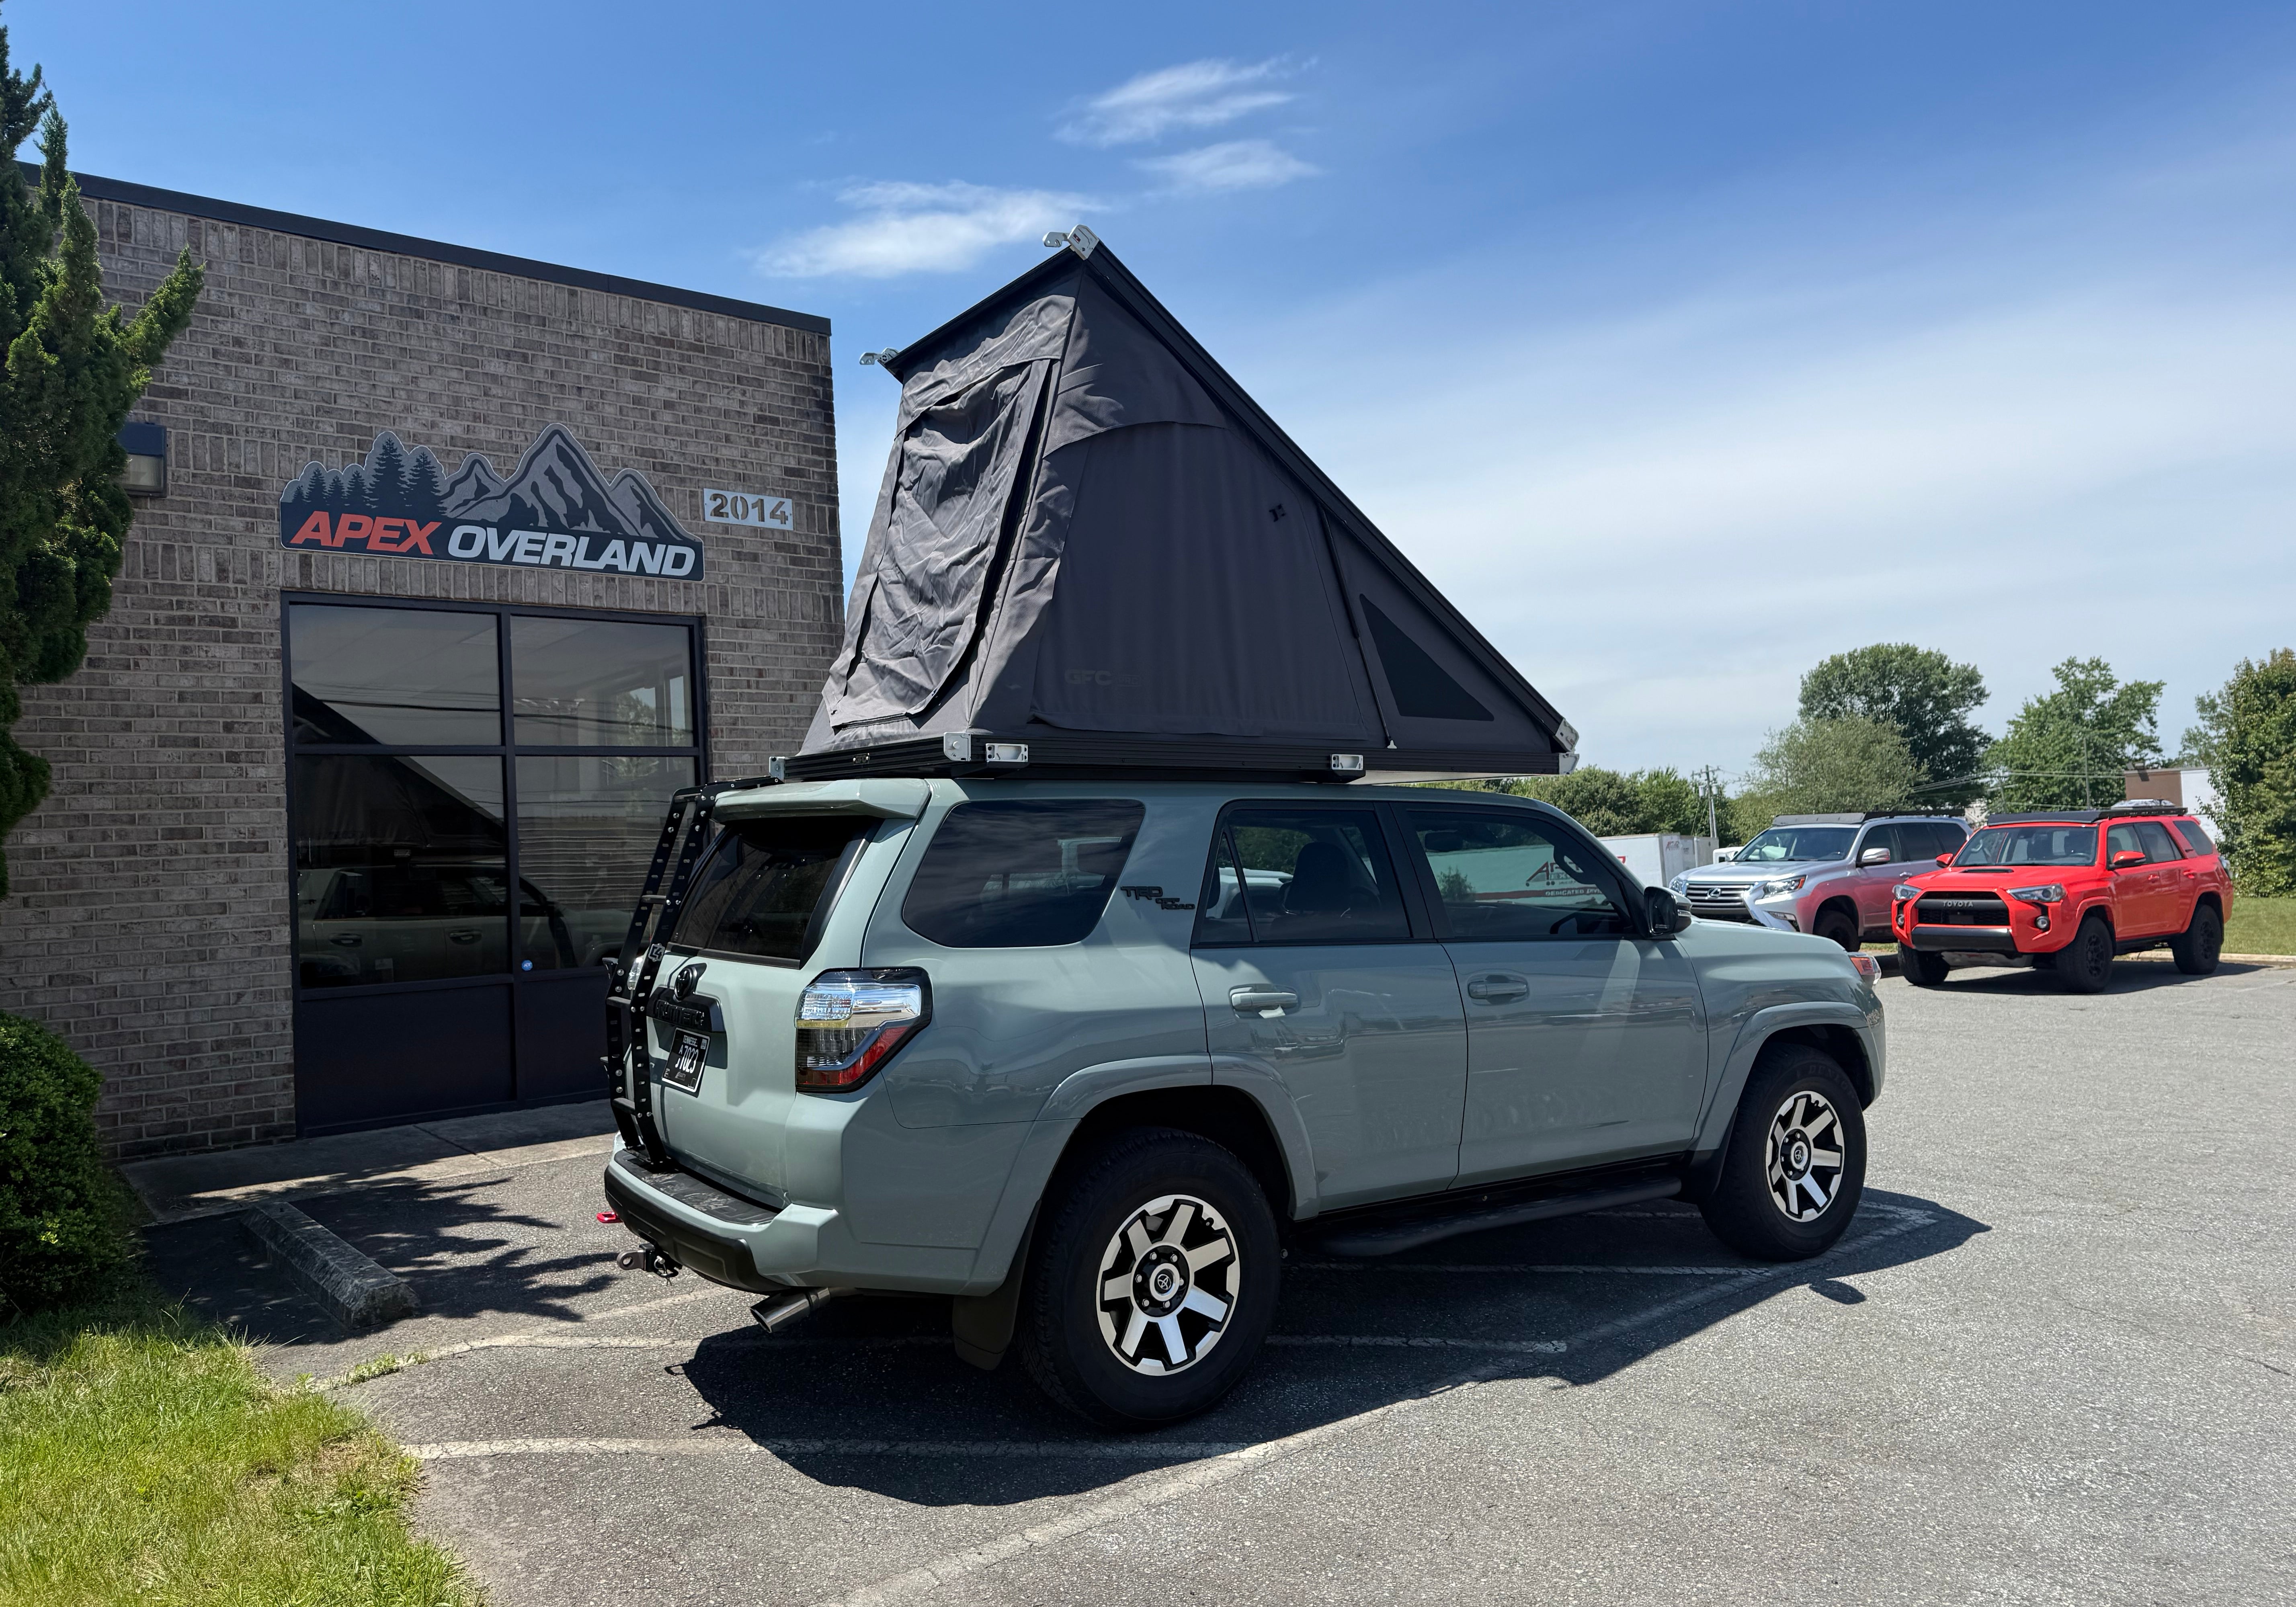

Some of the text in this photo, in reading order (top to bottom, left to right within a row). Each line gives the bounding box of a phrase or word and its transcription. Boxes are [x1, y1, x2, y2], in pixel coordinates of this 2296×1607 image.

[709, 493, 788, 524] 2014
[290, 510, 695, 576] APEX OVERLAND
[1064, 669, 1112, 685] GFC
[1121, 886, 1163, 900] TRD
